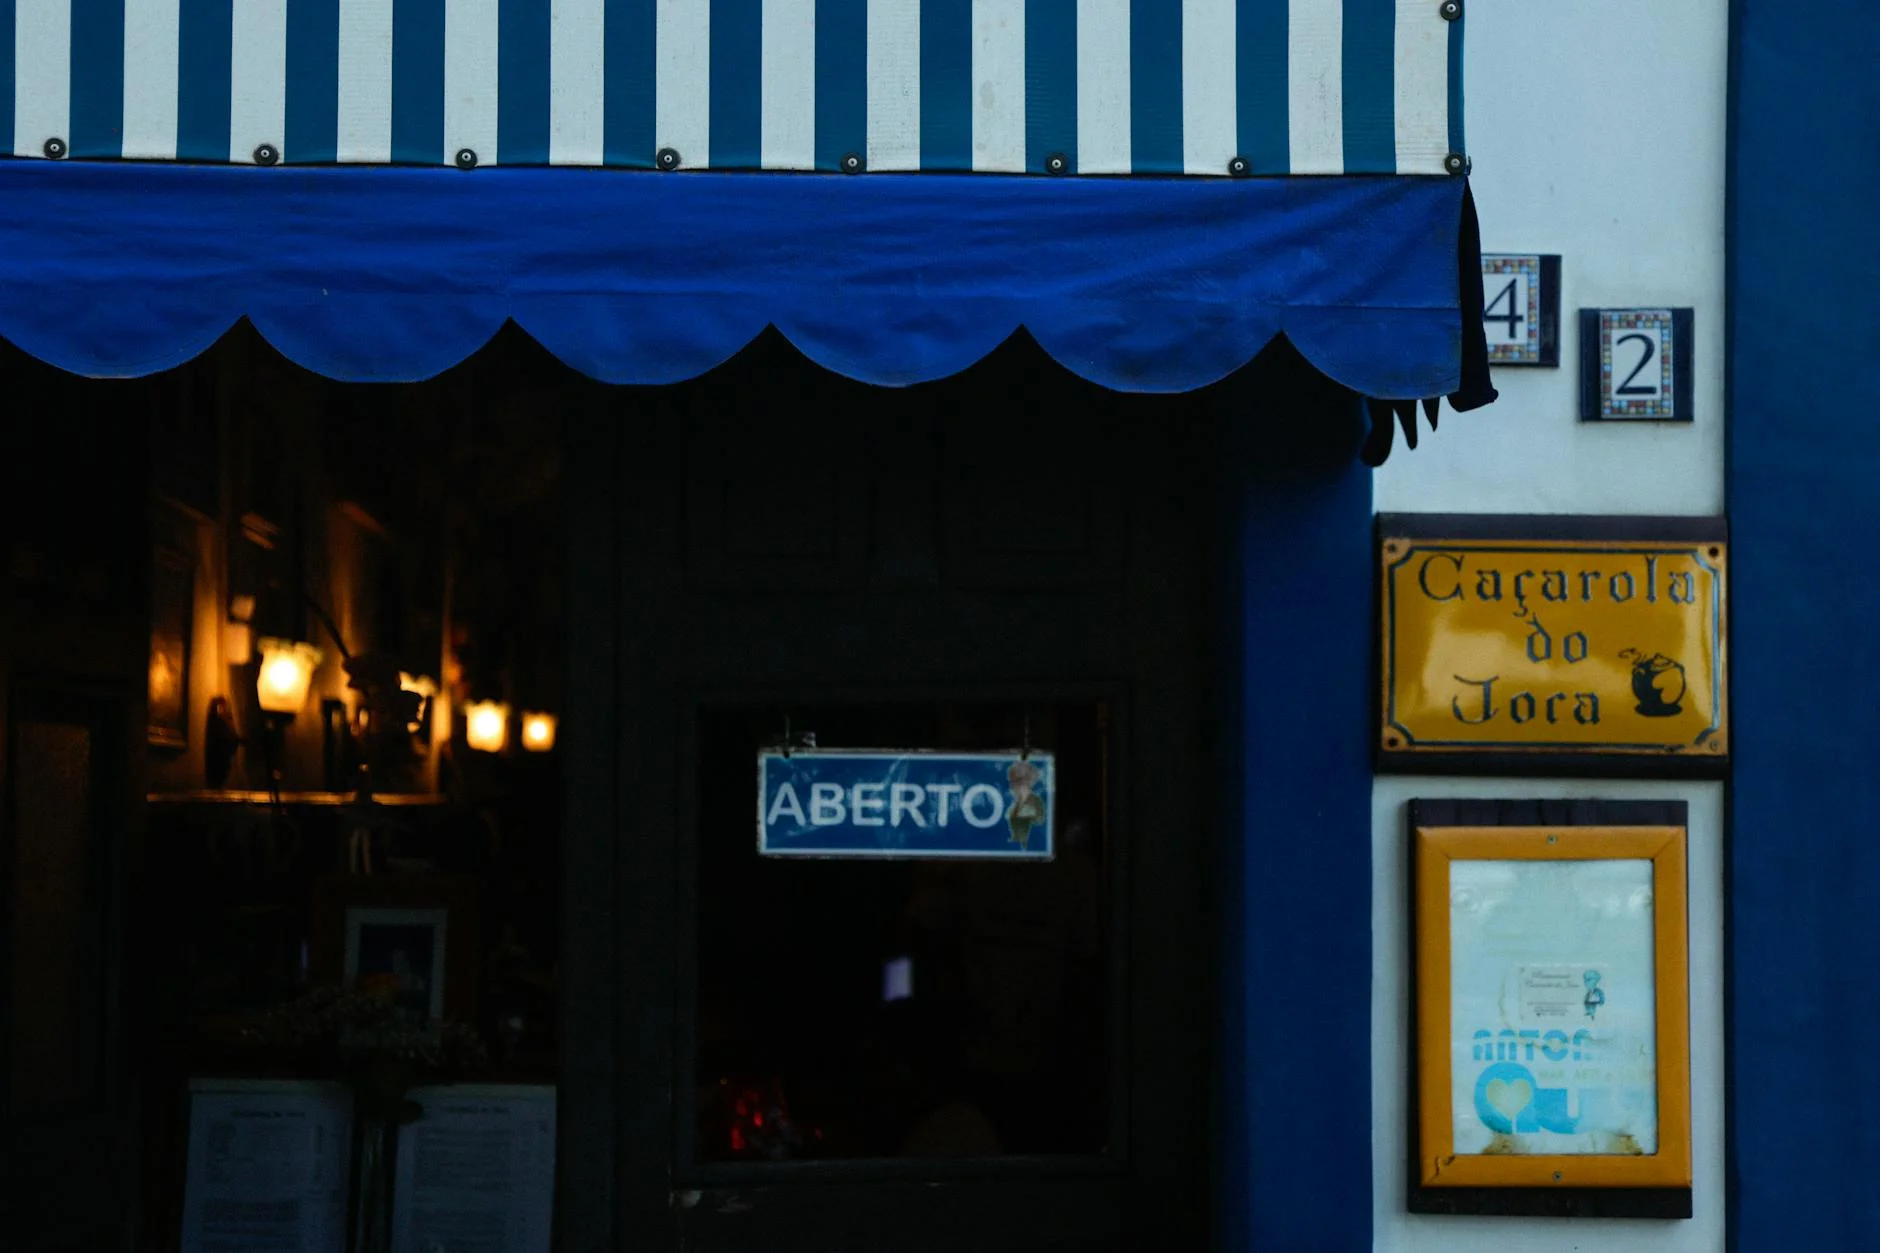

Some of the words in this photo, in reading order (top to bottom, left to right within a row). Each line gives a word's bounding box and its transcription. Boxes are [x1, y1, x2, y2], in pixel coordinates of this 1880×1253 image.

[1483, 277, 1524, 339] 4
[1615, 333, 1657, 395] 2
[1418, 553, 1696, 617] Caçarola
[1526, 612, 1588, 664] do
[767, 782, 1004, 829] ABERTO
